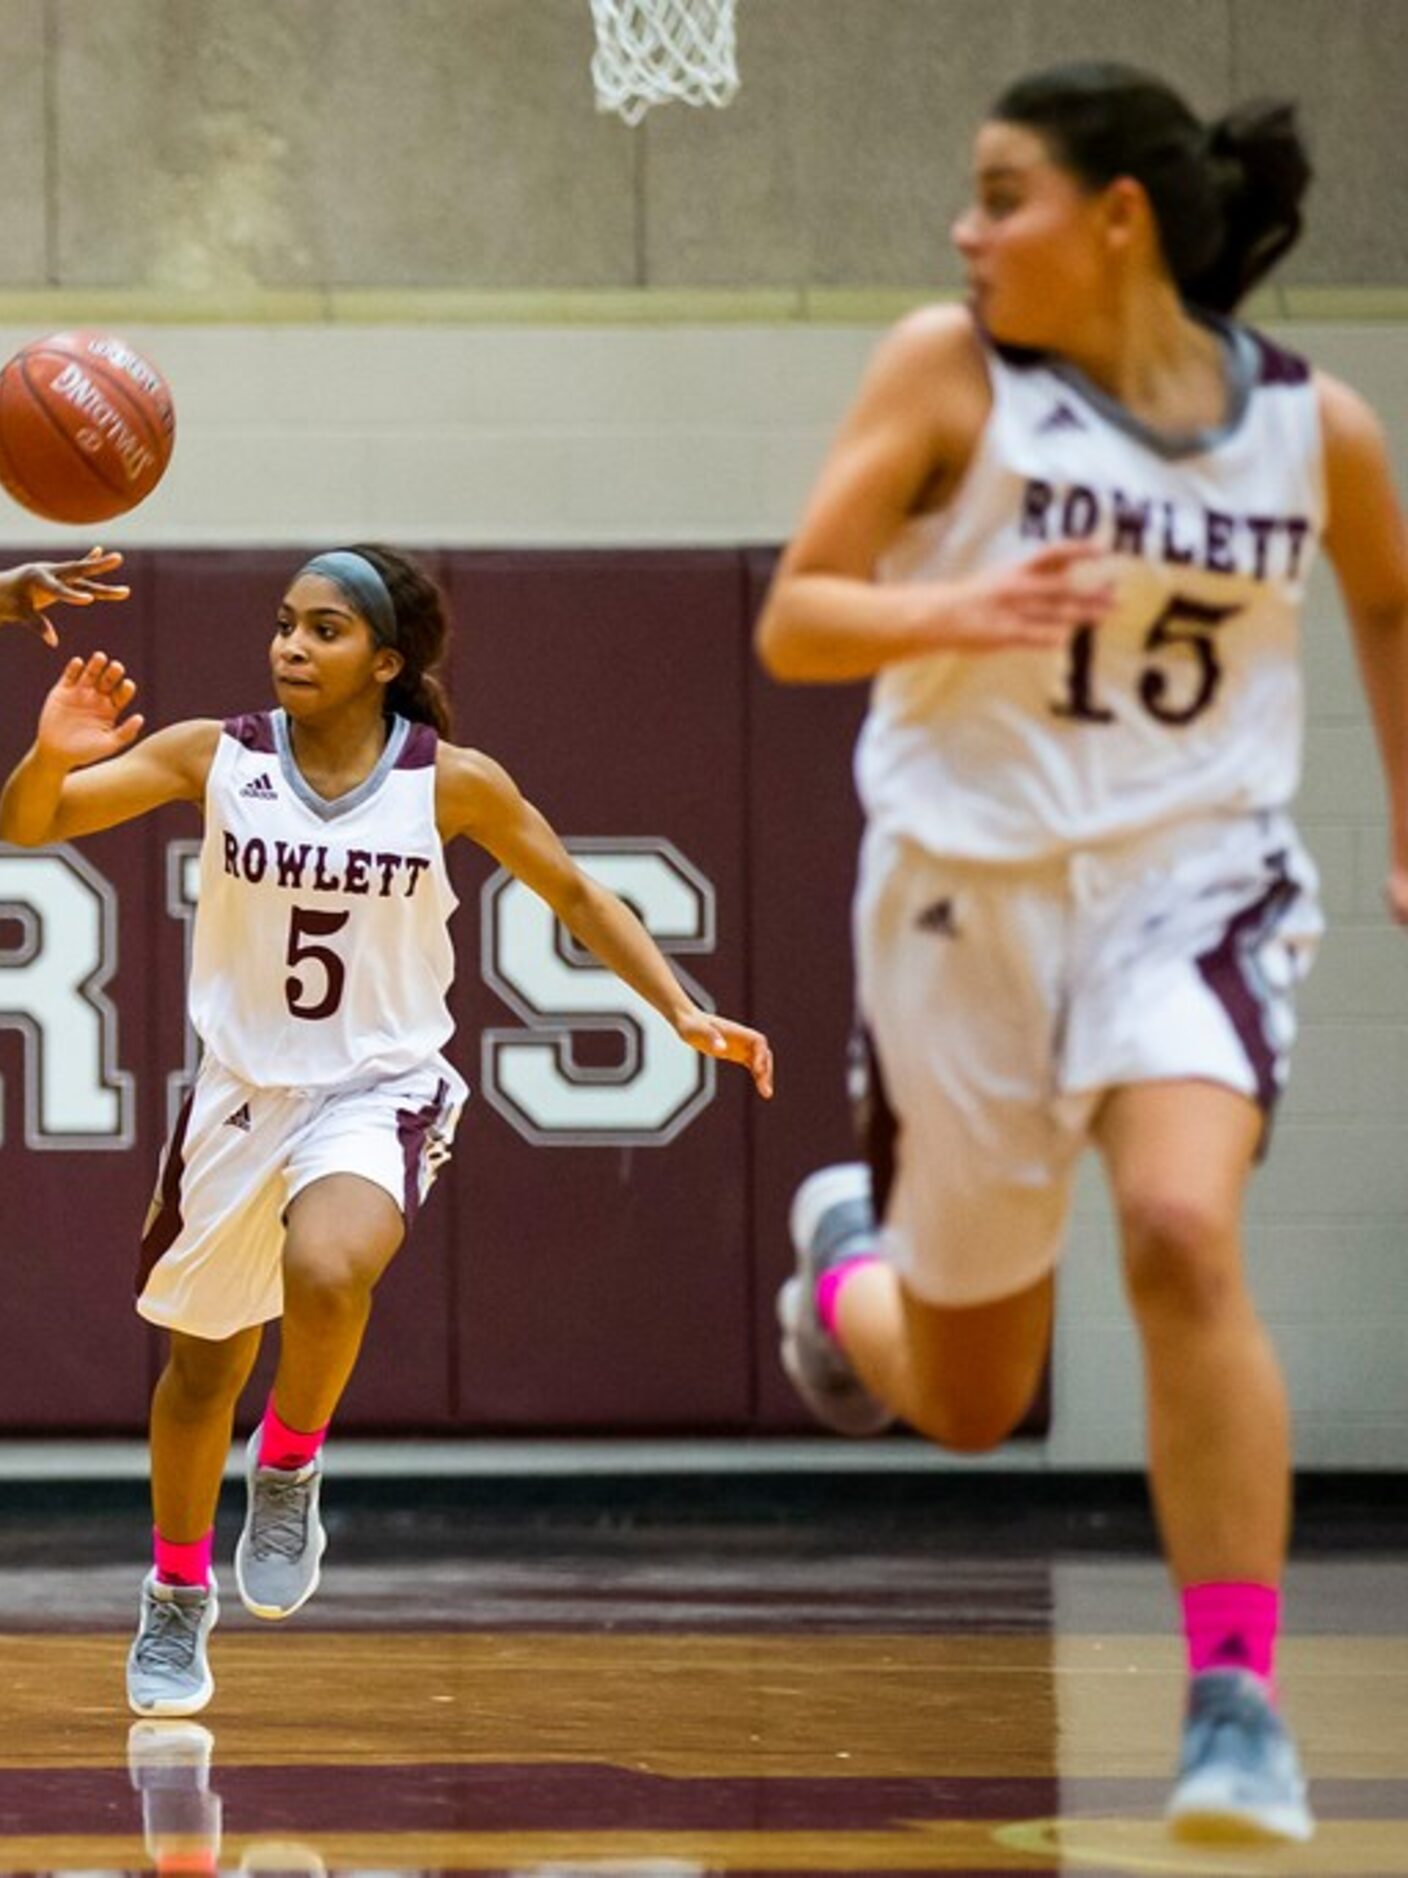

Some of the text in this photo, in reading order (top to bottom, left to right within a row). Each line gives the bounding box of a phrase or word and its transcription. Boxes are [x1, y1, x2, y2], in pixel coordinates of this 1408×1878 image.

[1022, 480, 1310, 582] ROWLETT
[1051, 592, 1246, 727] 15
[222, 830, 432, 897] ROWLETT
[285, 905, 350, 1021] 5
